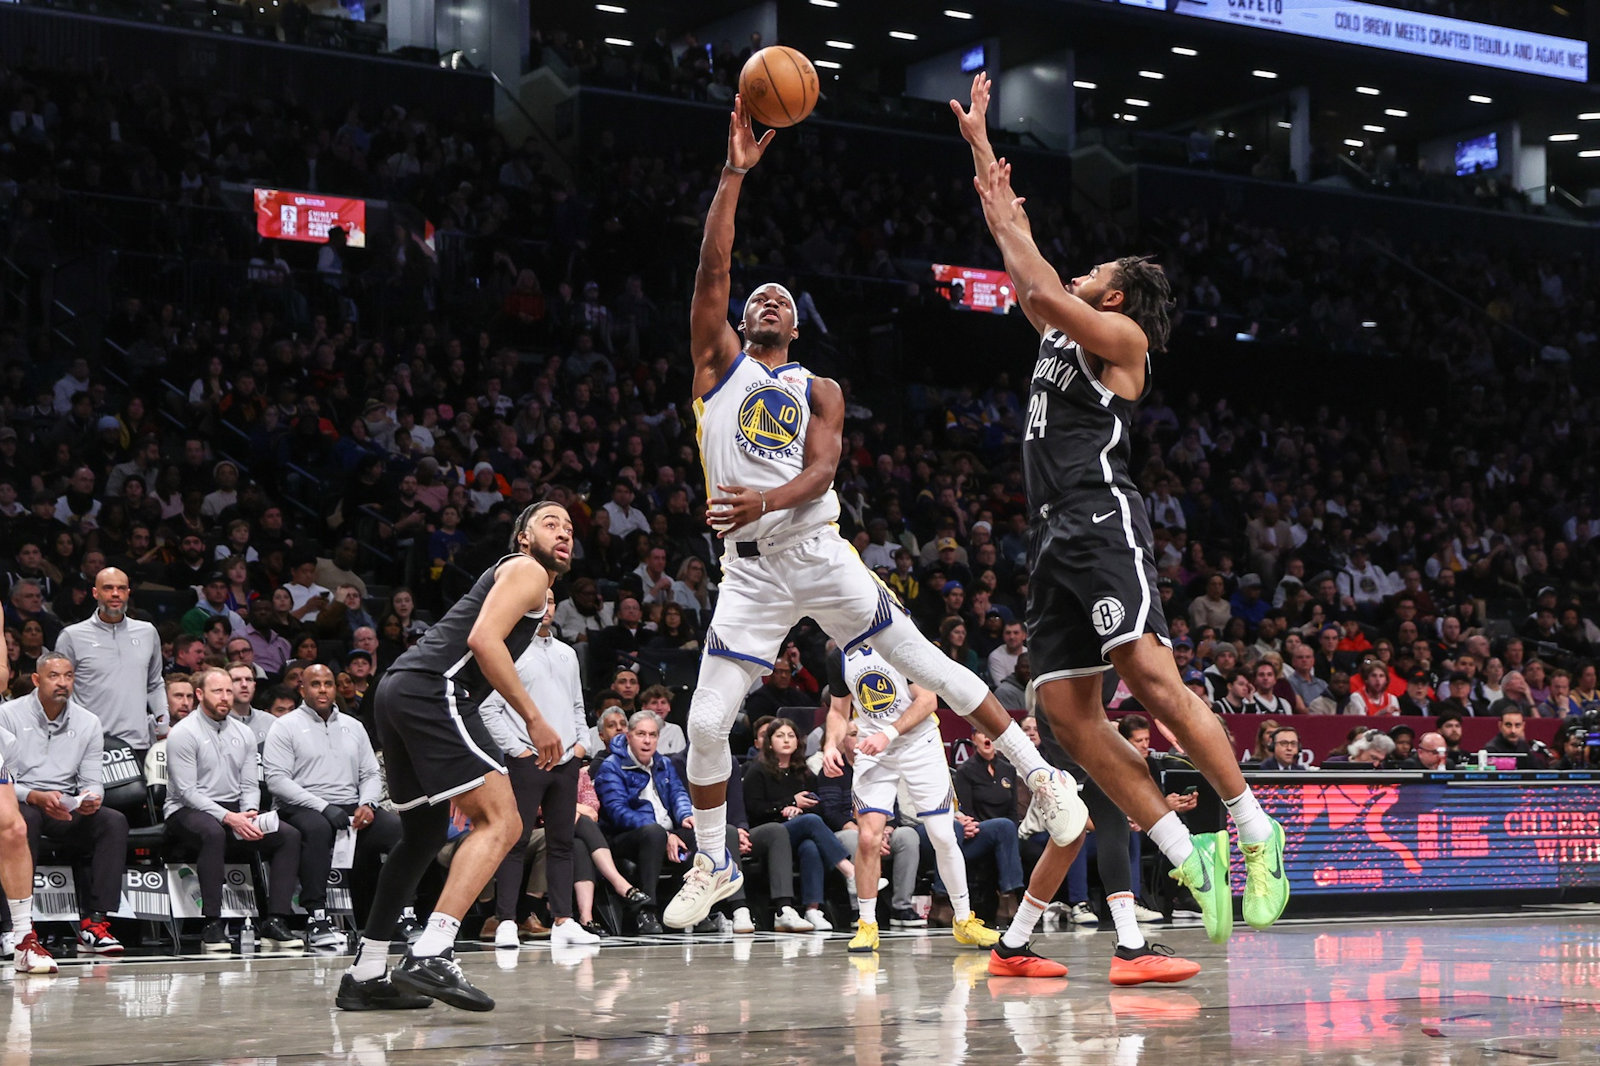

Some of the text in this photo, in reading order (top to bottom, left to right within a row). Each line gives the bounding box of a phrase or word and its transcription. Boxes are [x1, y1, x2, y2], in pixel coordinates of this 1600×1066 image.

[1335, 12, 1360, 32] COLD
[1362, 16, 1392, 37] BREW
[1395, 22, 1427, 43] MEETS
[1429, 28, 1471, 50] CRAFTED
[1473, 35, 1510, 56] TEQUILA
[1513, 42, 1533, 60] AND
[1535, 46, 1565, 66] AGAVE
[778, 404, 796, 424] 10
[1025, 391, 1048, 441] 24
[735, 429, 799, 460] WARRIORS
[876, 678, 888, 691] 61
[862, 698, 902, 719] WARRIORS
[1503, 811, 1600, 836] CHEERS
[1534, 839, 1600, 863] WITH
